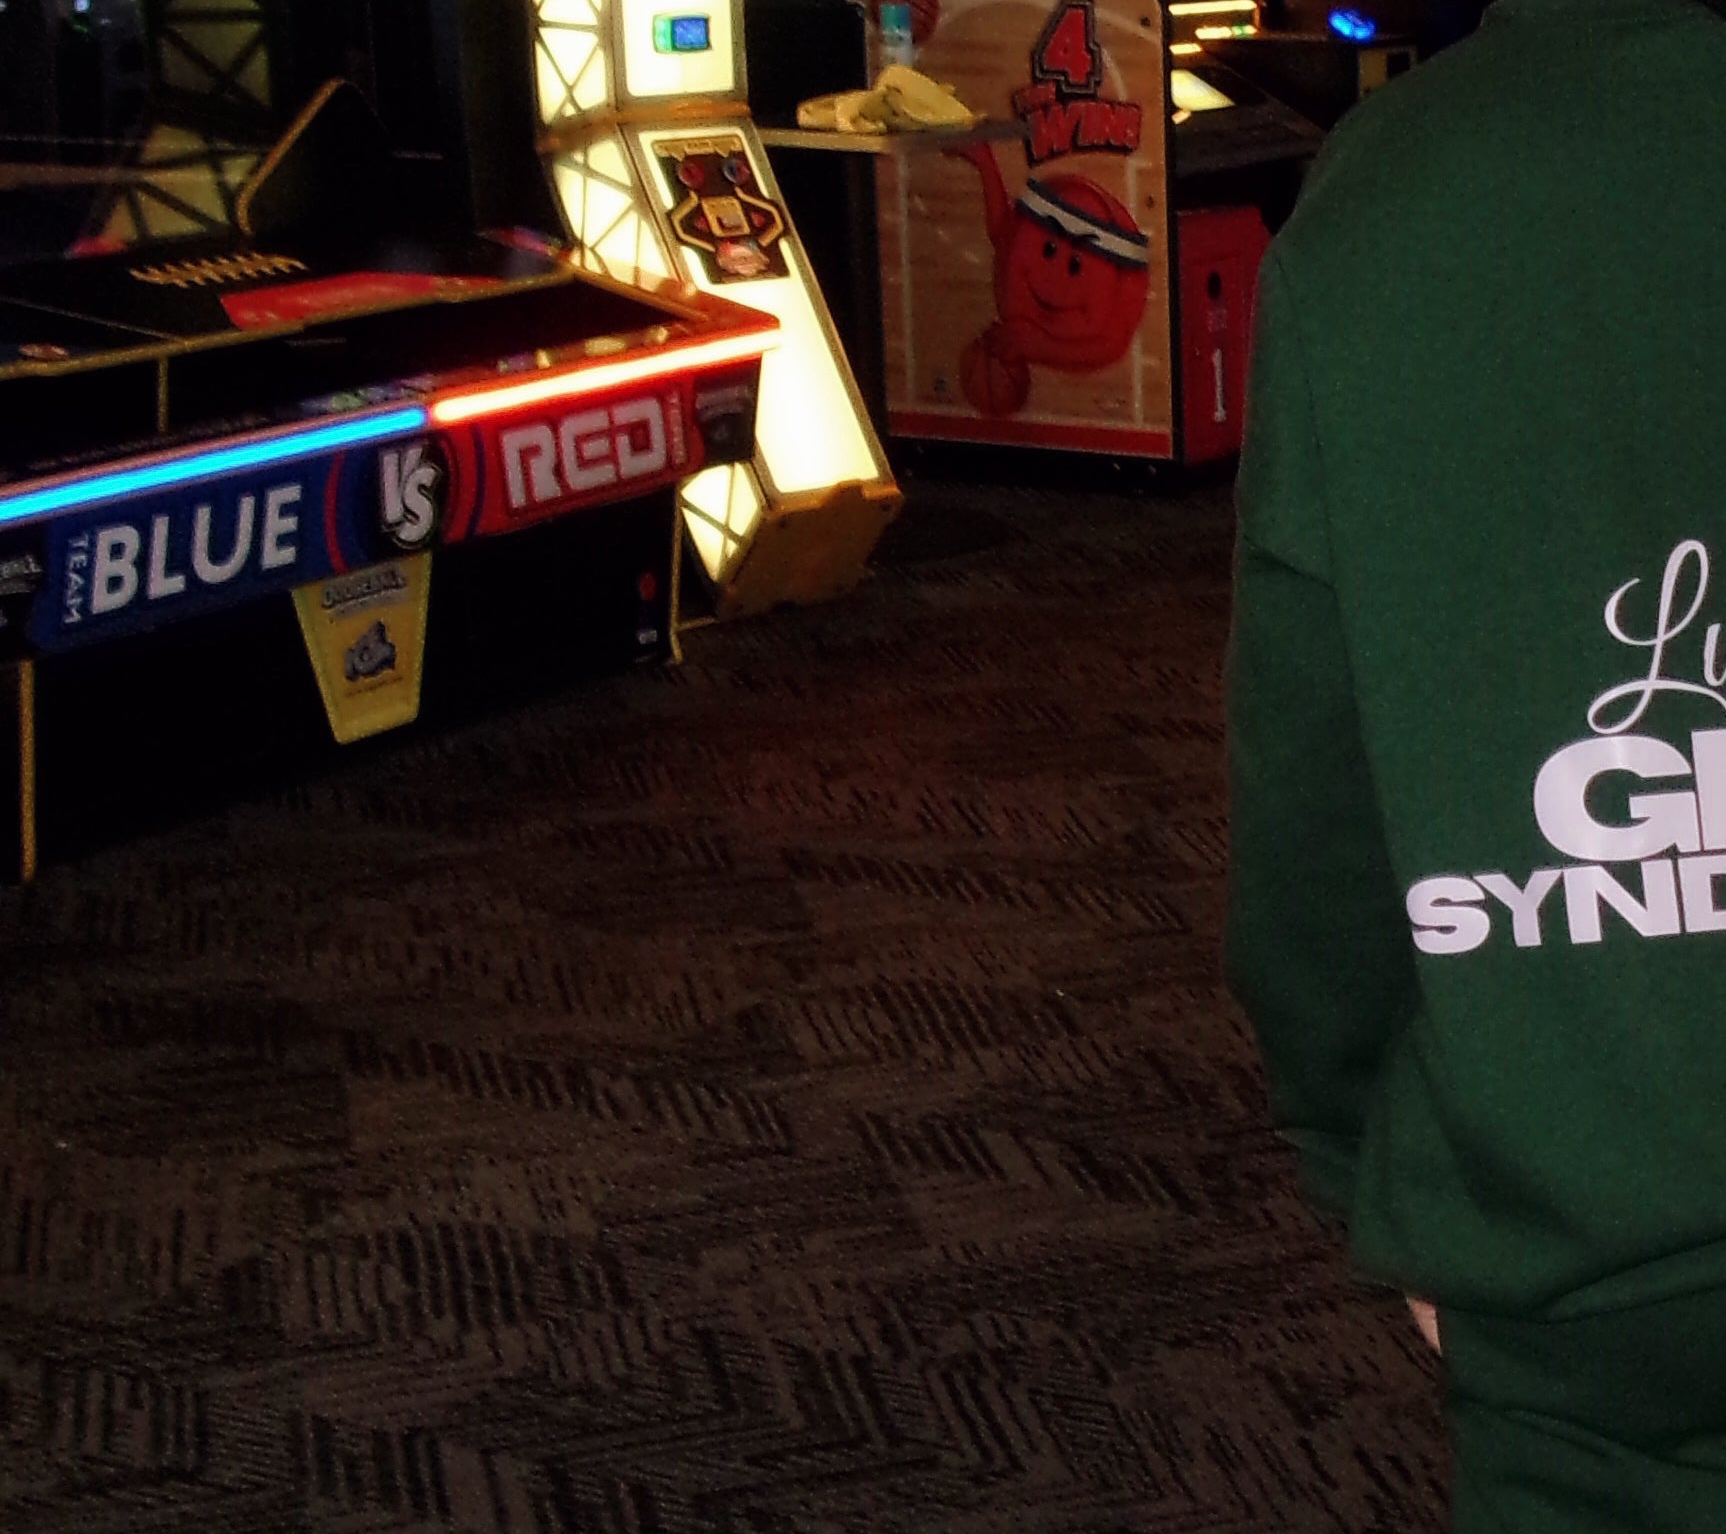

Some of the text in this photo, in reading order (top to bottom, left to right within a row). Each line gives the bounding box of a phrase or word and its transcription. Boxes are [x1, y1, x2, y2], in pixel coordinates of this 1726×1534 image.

[1044, 6, 1093, 85] 4
[376, 443, 439, 545] VS
[501, 396, 668, 510] RED
[63, 533, 90, 624] TEAM
[90, 483, 303, 616] BLUE
